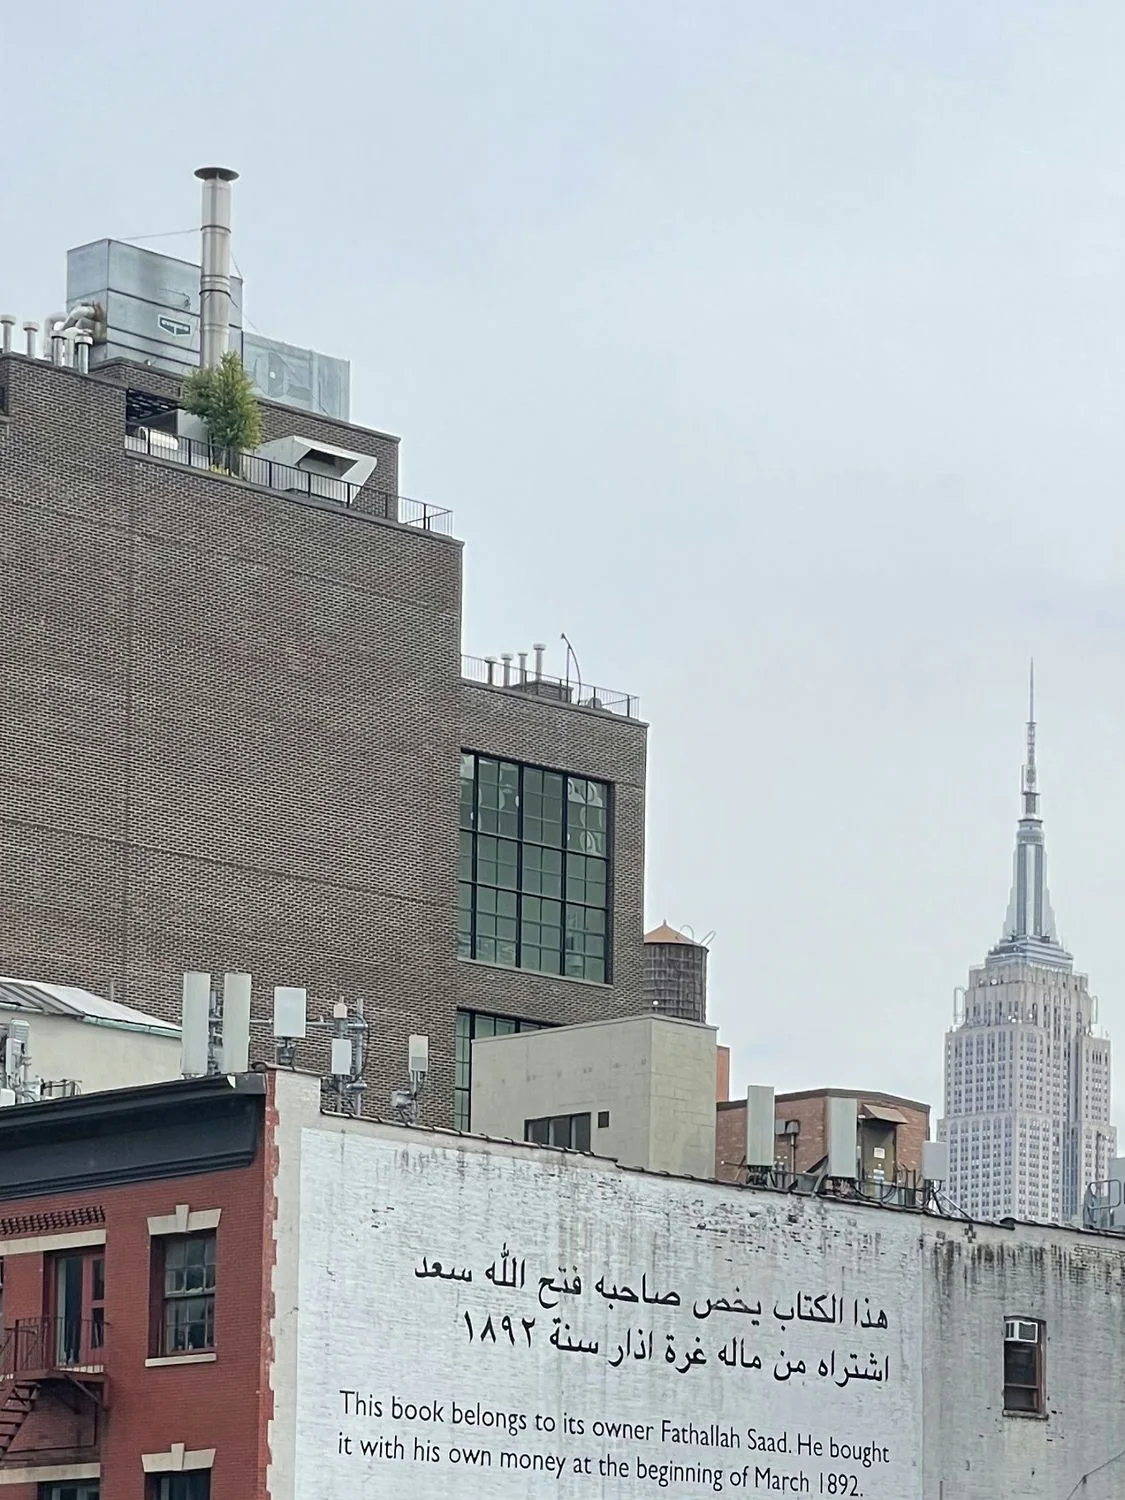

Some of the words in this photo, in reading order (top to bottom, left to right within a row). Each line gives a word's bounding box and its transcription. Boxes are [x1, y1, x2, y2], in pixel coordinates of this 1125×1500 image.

[415, 1257, 473, 1283] سعد
[538, 1265, 582, 1309] فتح
[595, 1274, 681, 1310] صاحبه
[694, 1286, 762, 1327] يخص
[464, 1310, 536, 1348] ١٨٩٢
[774, 1291, 843, 1332] الكتاب
[855, 1297, 889, 1330] هذا
[550, 1318, 599, 1355] سنة
[609, 1329, 653, 1368] اذار
[666, 1335, 707, 1374] غرة
[718, 1337, 762, 1370] ماله
[774, 1351, 806, 1382] من
[818, 1350, 889, 1388] اشتراه
[339, 1390, 383, 1418] This
[391, 1396, 444, 1423] book
[452, 1401, 527, 1437] belongs
[536, 1414, 556, 1432] to
[563, 1413, 585, 1435] its
[593, 1421, 654, 1441] owner
[661, 1420, 740, 1449] Fathallah
[747, 1428, 792, 1454] Saad.
[798, 1433, 823, 1457] He
[830, 1436, 890, 1468] bought
[338, 1431, 352, 1455] it
[360, 1436, 404, 1460] with
[414, 1438, 440, 1463] his
[449, 1449, 491, 1466] own
[500, 1453, 566, 1480] money
[573, 1458, 592, 1475] at
[599, 1454, 629, 1478] the
[637, 1456, 723, 1492] beginning
[730, 1466, 750, 1487] of
[755, 1467, 809, 1493] March
[820, 1472, 864, 1497] 1892.
